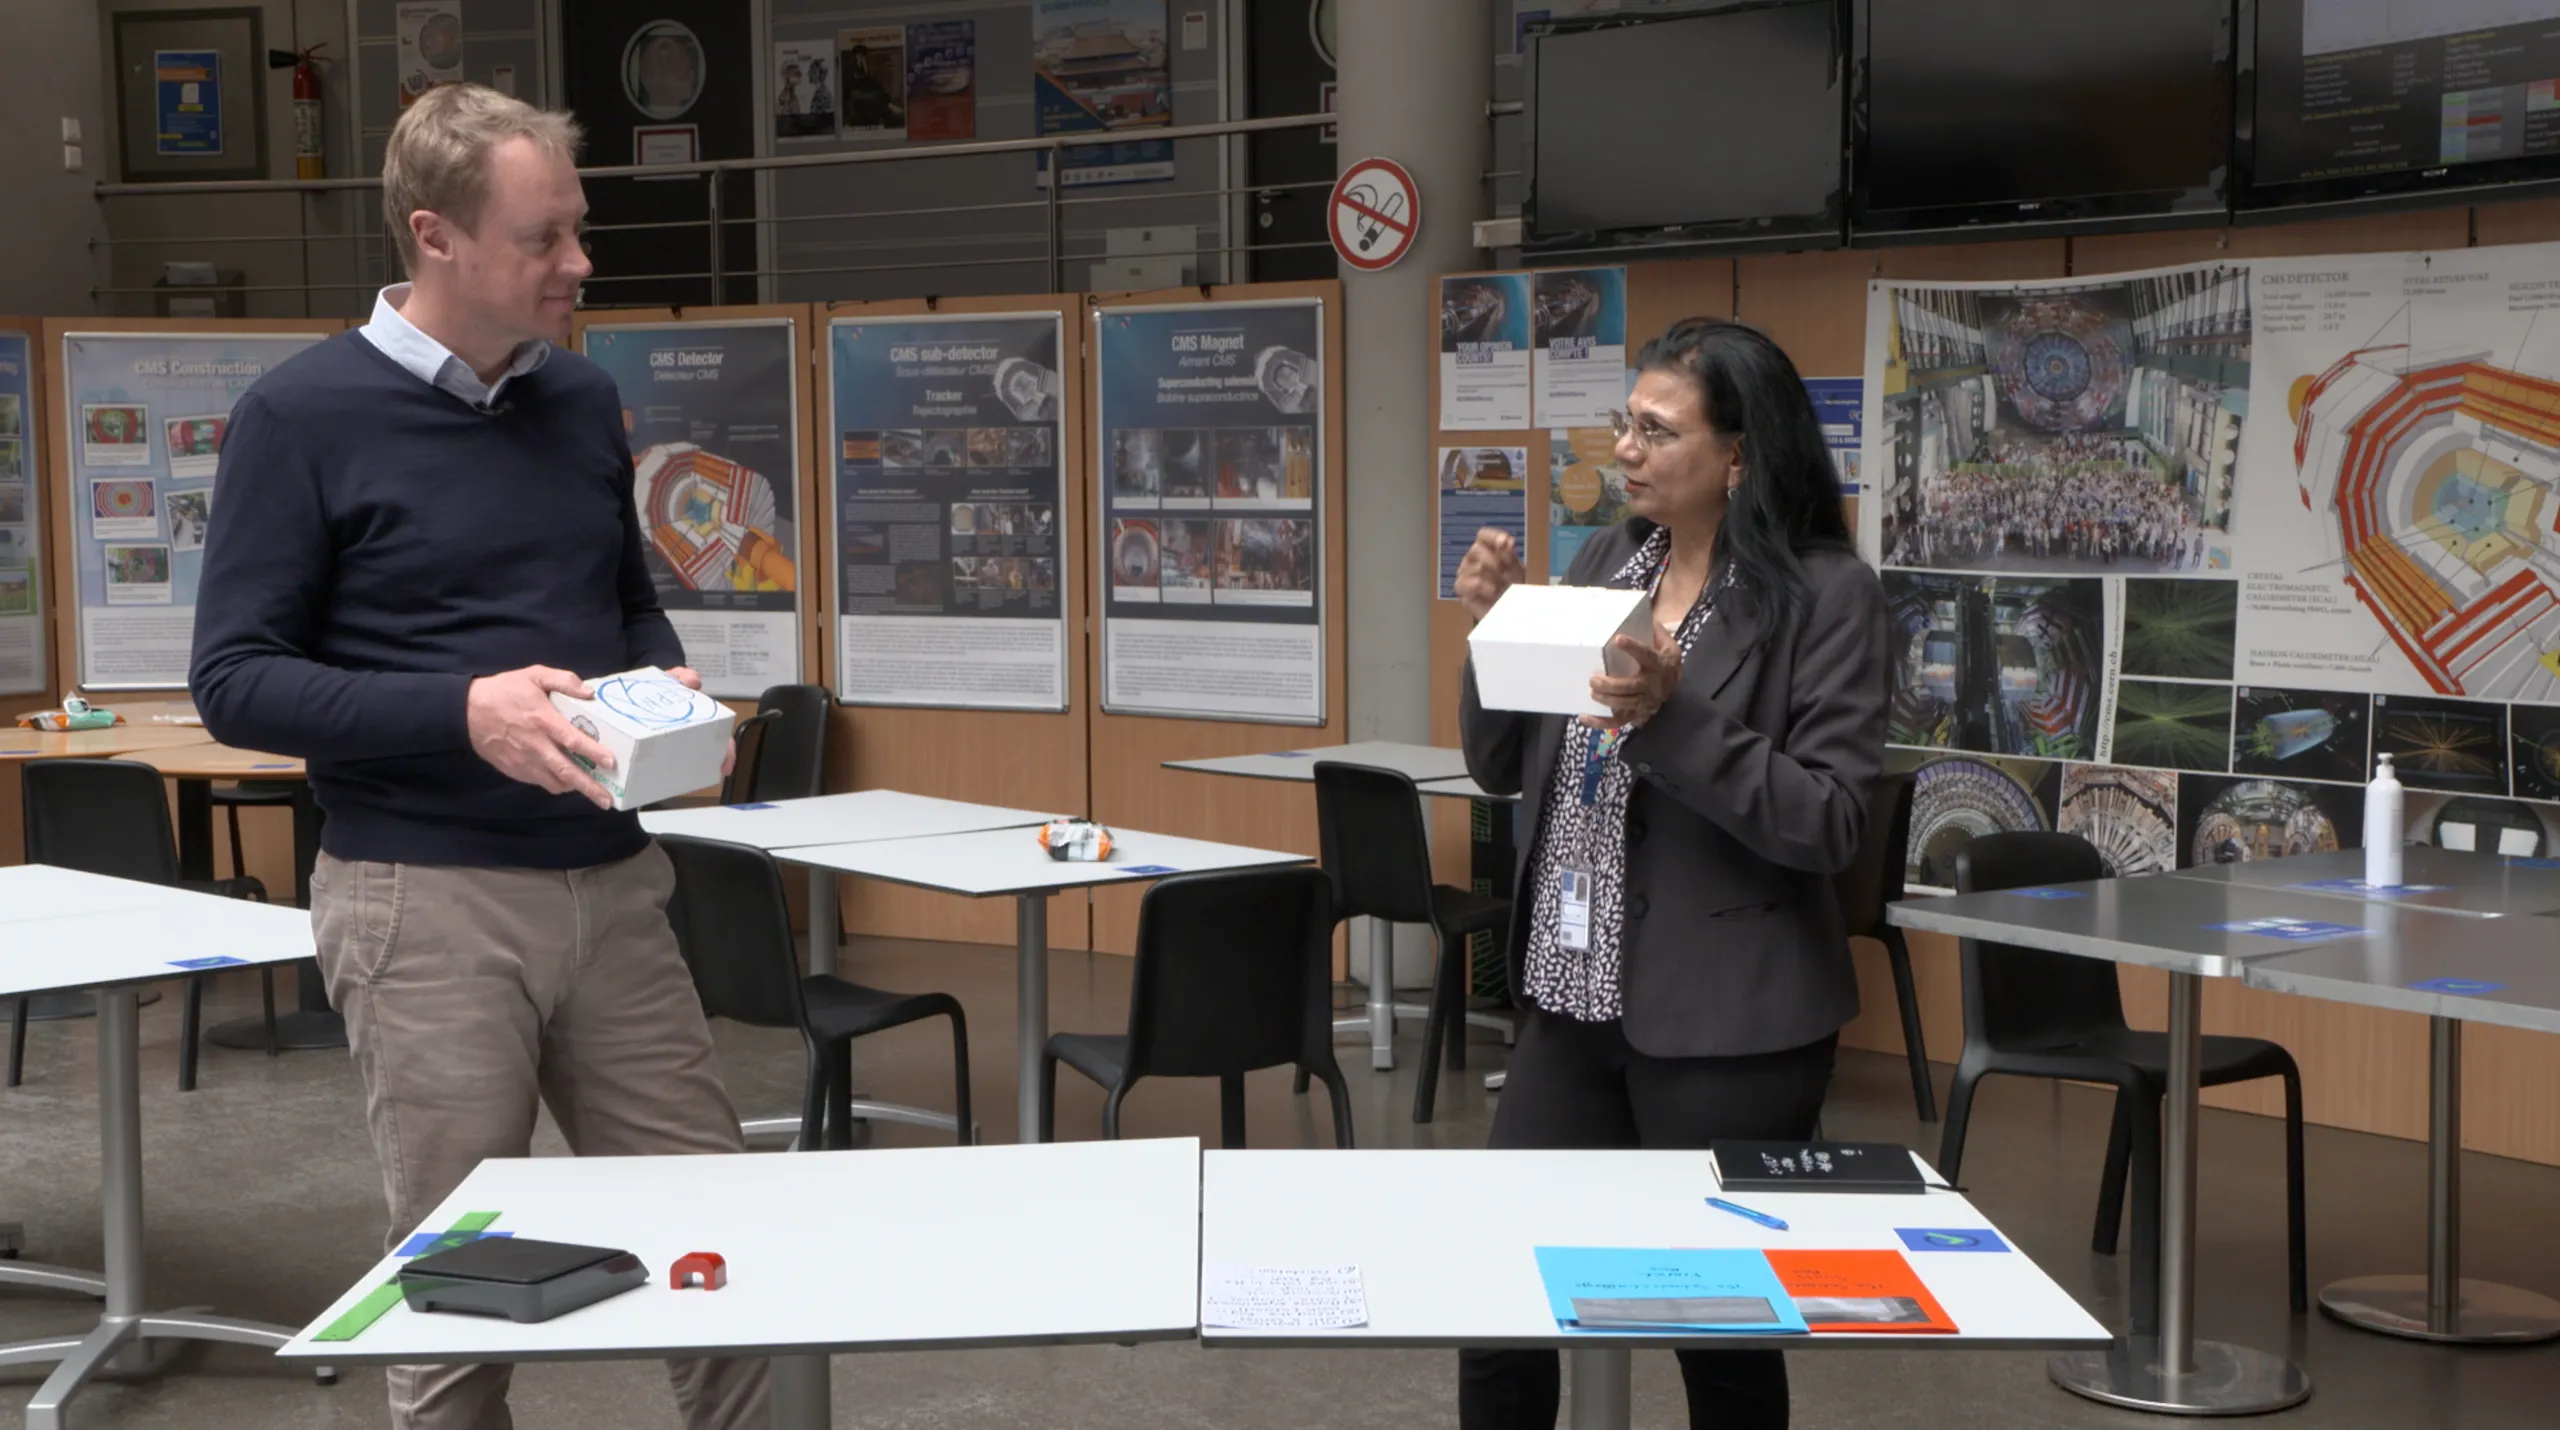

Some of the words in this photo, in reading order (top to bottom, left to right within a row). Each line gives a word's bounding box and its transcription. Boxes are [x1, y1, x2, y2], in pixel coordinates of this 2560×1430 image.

[2262, 274, 2286, 286] CMS
[2287, 272, 2350, 285] DETECTOR
[1172, 335, 1198, 352] CMS
[1201, 334, 1245, 353] Magnet
[1457, 342, 1479, 352] YOUR
[1480, 341, 1512, 352] OPINION
[1550, 338, 1577, 349] VOTRE
[1578, 336, 1597, 347] AVIS
[650, 352, 676, 367] CMS
[678, 352, 724, 366] Detector
[890, 347, 918, 362] CMS
[921, 345, 1000, 361] sub-detector
[1456, 353, 1493, 364] COUNTS!
[1549, 348, 1581, 359] COMPTE
[1212, 354, 1237, 367] CMS
[134, 361, 168, 375] CMS
[171, 360, 262, 375] Construction
[697, 368, 719, 380] CMS
[925, 390, 963, 402] Tracker
[2247, 572, 2284, 580] CRYSTAL
[2246, 582, 2331, 593] ELECTROMAGNETIC
[2246, 593, 2307, 603] CALORIMETER
[2309, 595, 2338, 605] (ECAL)
[2250, 649, 2288, 659] HADRON
[2289, 651, 2350, 663] CALORIMETER
[2100, 652, 2118, 757] http://cms.cern.ch
